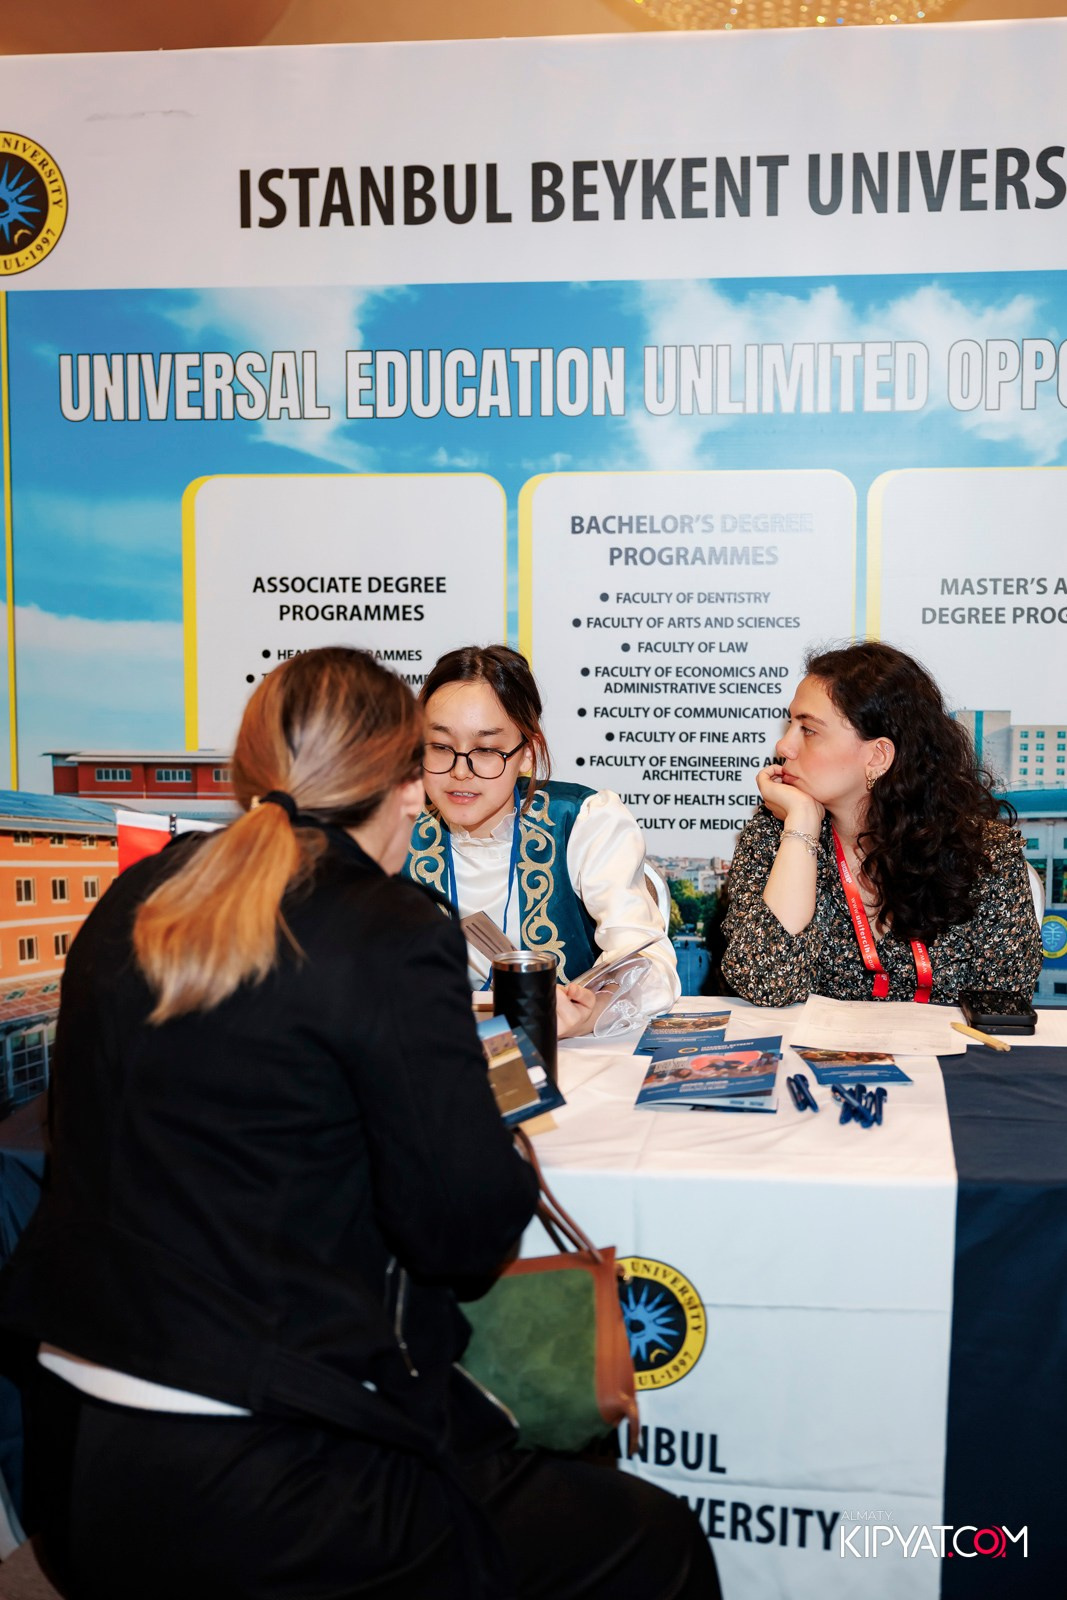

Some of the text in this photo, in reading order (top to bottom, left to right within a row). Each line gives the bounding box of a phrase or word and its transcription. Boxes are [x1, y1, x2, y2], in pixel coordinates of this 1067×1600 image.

[239, 145, 1067, 229] ISTANBUL BEYKENT UNIVERS
[58, 337, 1067, 422] UNIVERSAL EDUCATION UNLIMITED OPP
[720, 512, 814, 534] DEGREE
[608, 545, 779, 567] PROGRAMMES
[251, 575, 447, 594] ASSOCIATE DEGREE
[615, 591, 772, 605] FACULTY OF DENTISTRY
[278, 604, 425, 622] PROGRAMMES
[921, 606, 1007, 625] DEGREE
[585, 616, 801, 629] FACULTY OF ARTS AND SCIENCES
[637, 641, 749, 654] FACULTY OF LAW
[594, 665, 790, 679] FACULTY OF ECONOMICS AND
[603, 681, 783, 695] ADMINISTRATIVE SCIENCES
[593, 706, 651, 719] FACULTY
[652, 706, 672, 719] OF
[618, 730, 767, 744] FACULTY OF FINE ARTS
[589, 755, 786, 768] FACULTY OF ENGINEERING AN
[641, 769, 743, 782] ARCHITECTURE
[618, 793, 764, 806] ULTY OF HEALTH SCIEN
[636, 818, 748, 831] CULTY OF MEDICI
[626, 1423, 727, 1475] NBUL
[681, 1495, 840, 1551] ERSITY
